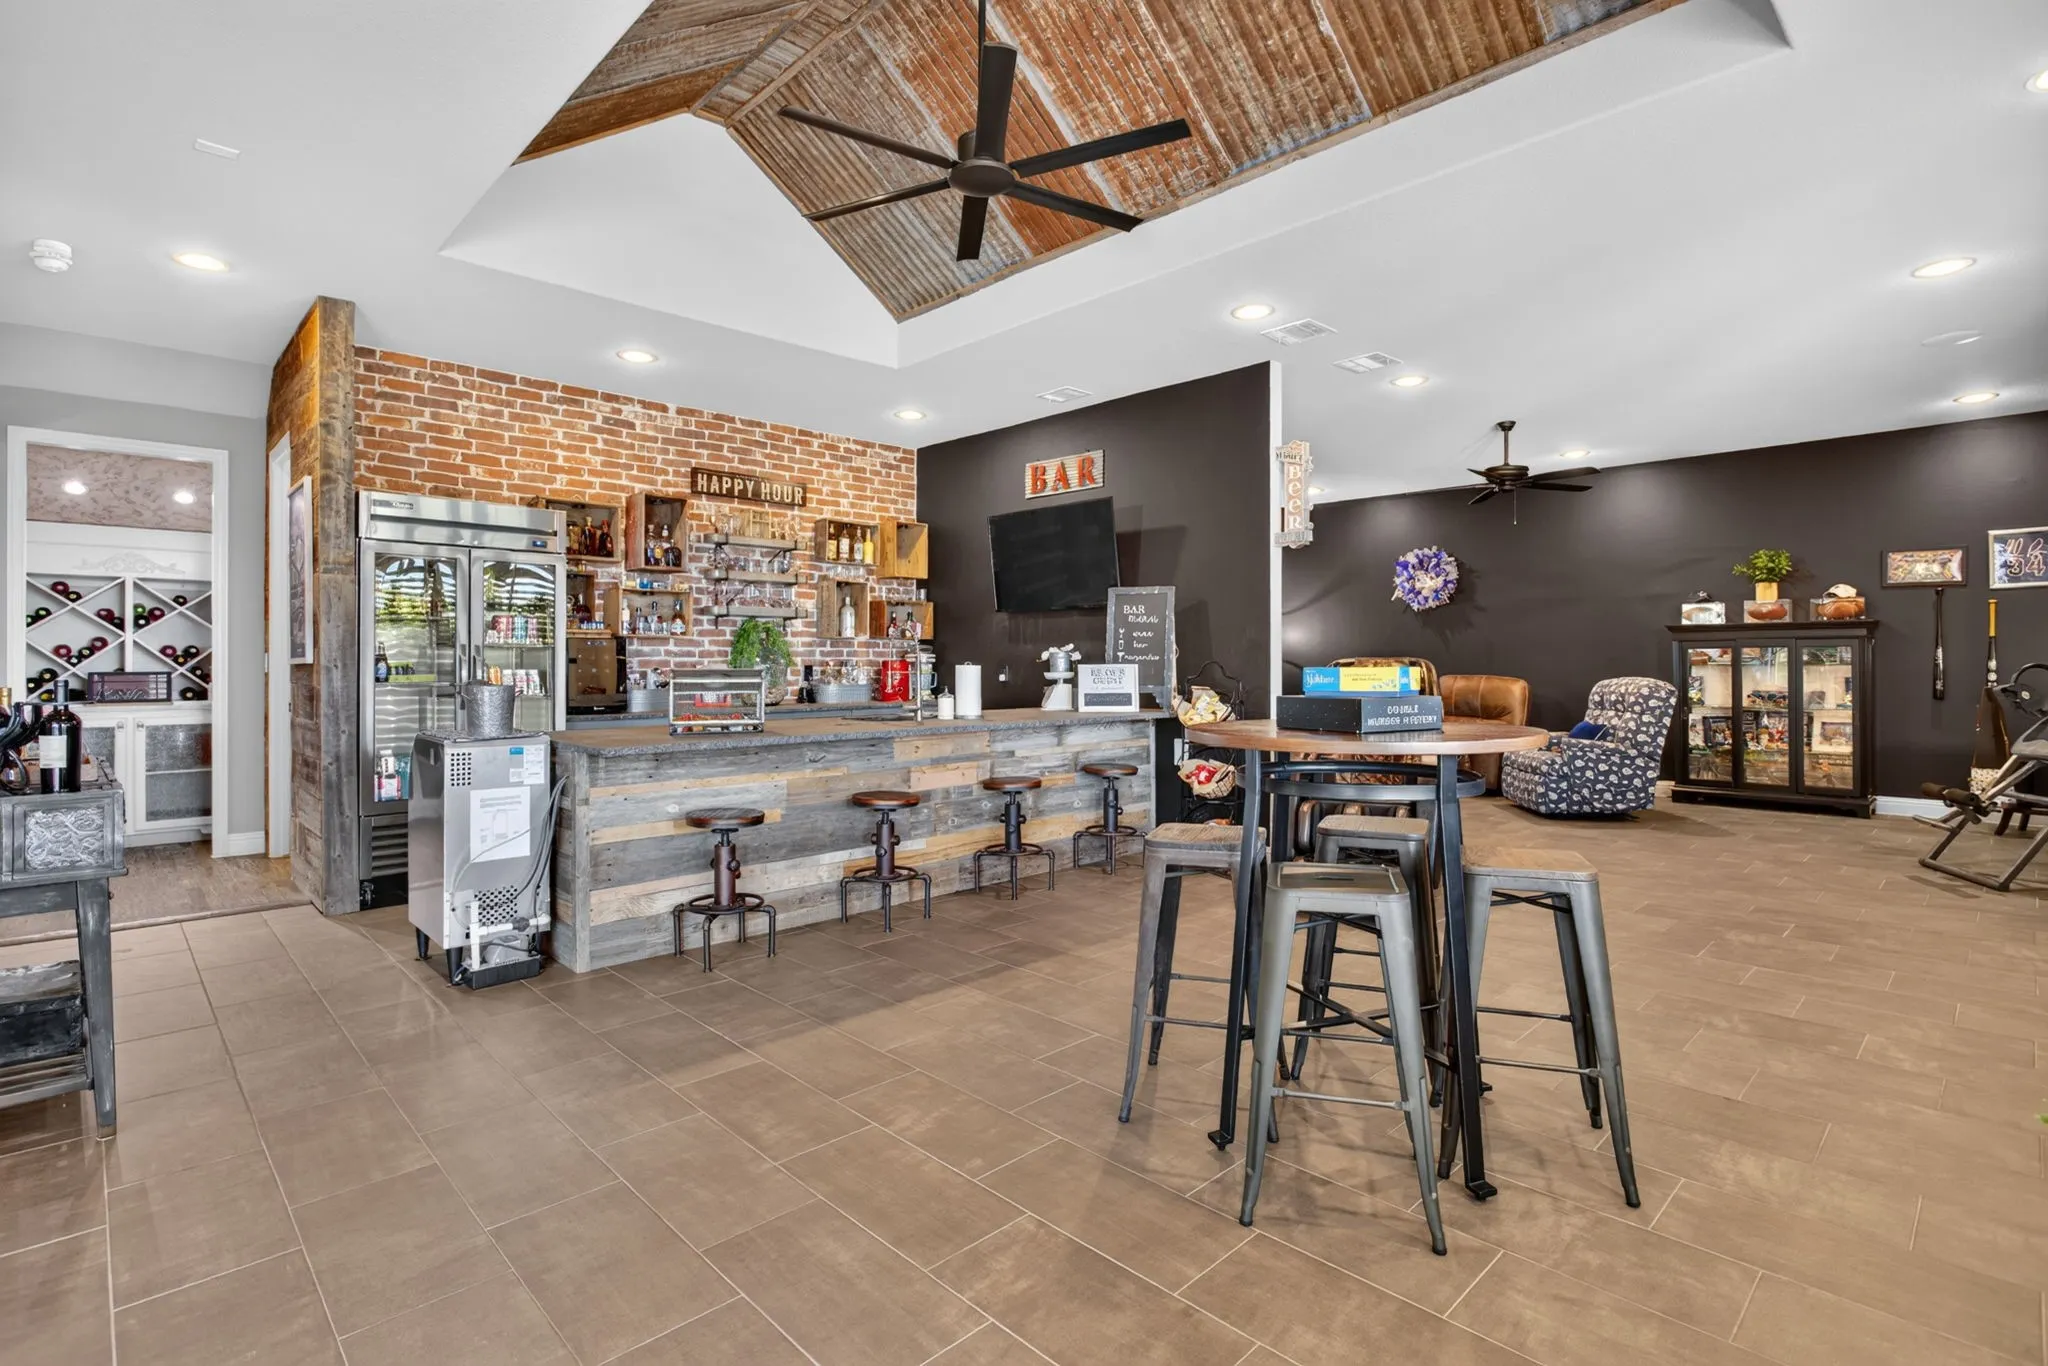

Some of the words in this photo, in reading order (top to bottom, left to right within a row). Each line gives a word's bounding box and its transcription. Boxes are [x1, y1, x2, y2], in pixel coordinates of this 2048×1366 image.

[697, 473, 755, 498] HAPPY
[761, 480, 803, 505] HOUR
[1029, 455, 1096, 495] BAR
[1123, 604, 1146, 614] BAR
